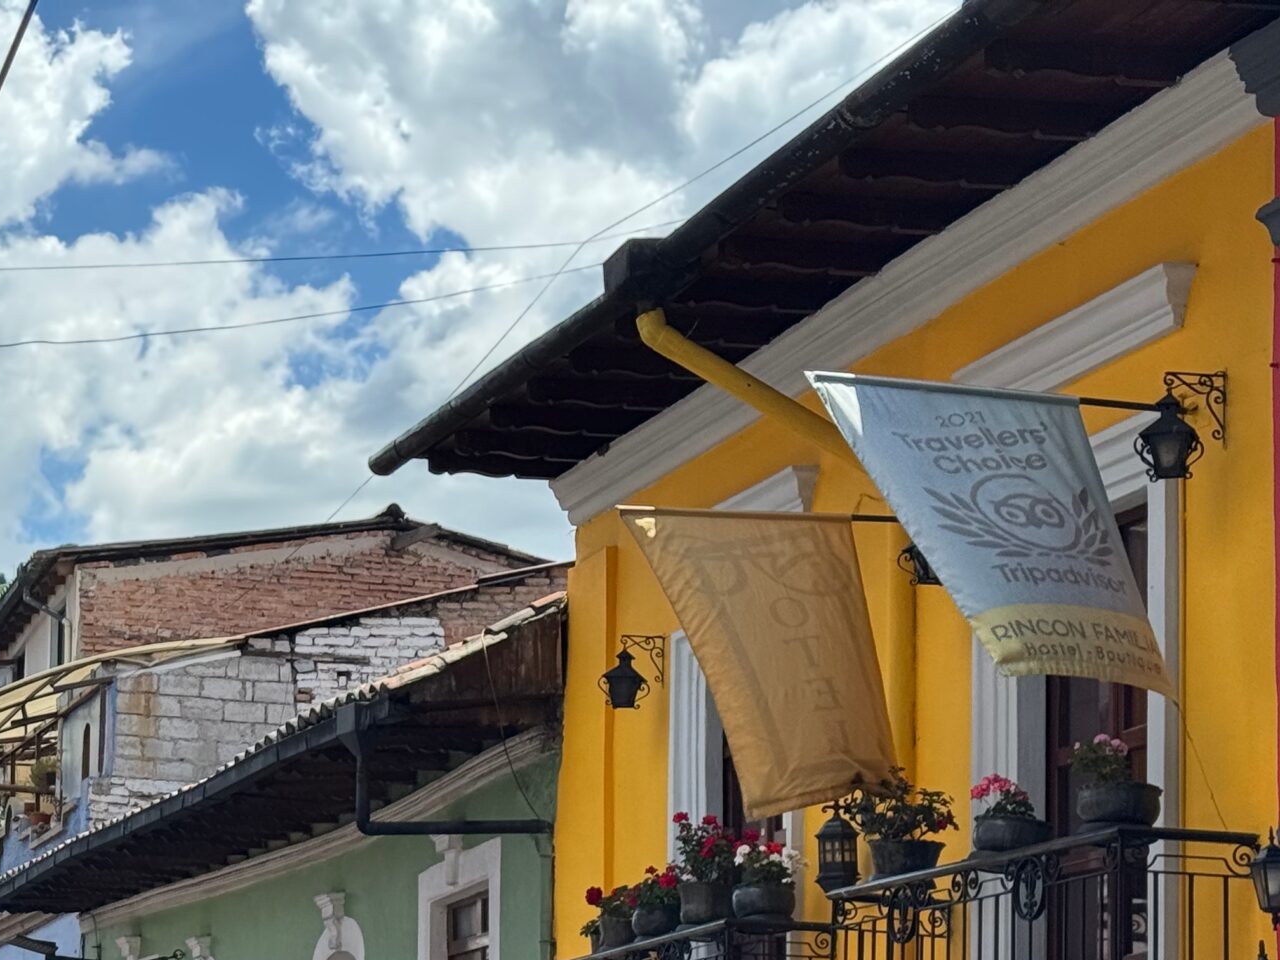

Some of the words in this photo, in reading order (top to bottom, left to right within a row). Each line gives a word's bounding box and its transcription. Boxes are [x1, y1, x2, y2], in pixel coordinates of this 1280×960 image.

[935, 411, 986, 428] 2021
[933, 449, 1047, 474] Choice
[991, 562, 1127, 595] Tripadvisor
[990, 618, 1086, 643] RINCON
[1024, 643, 1081, 659] Hostel
